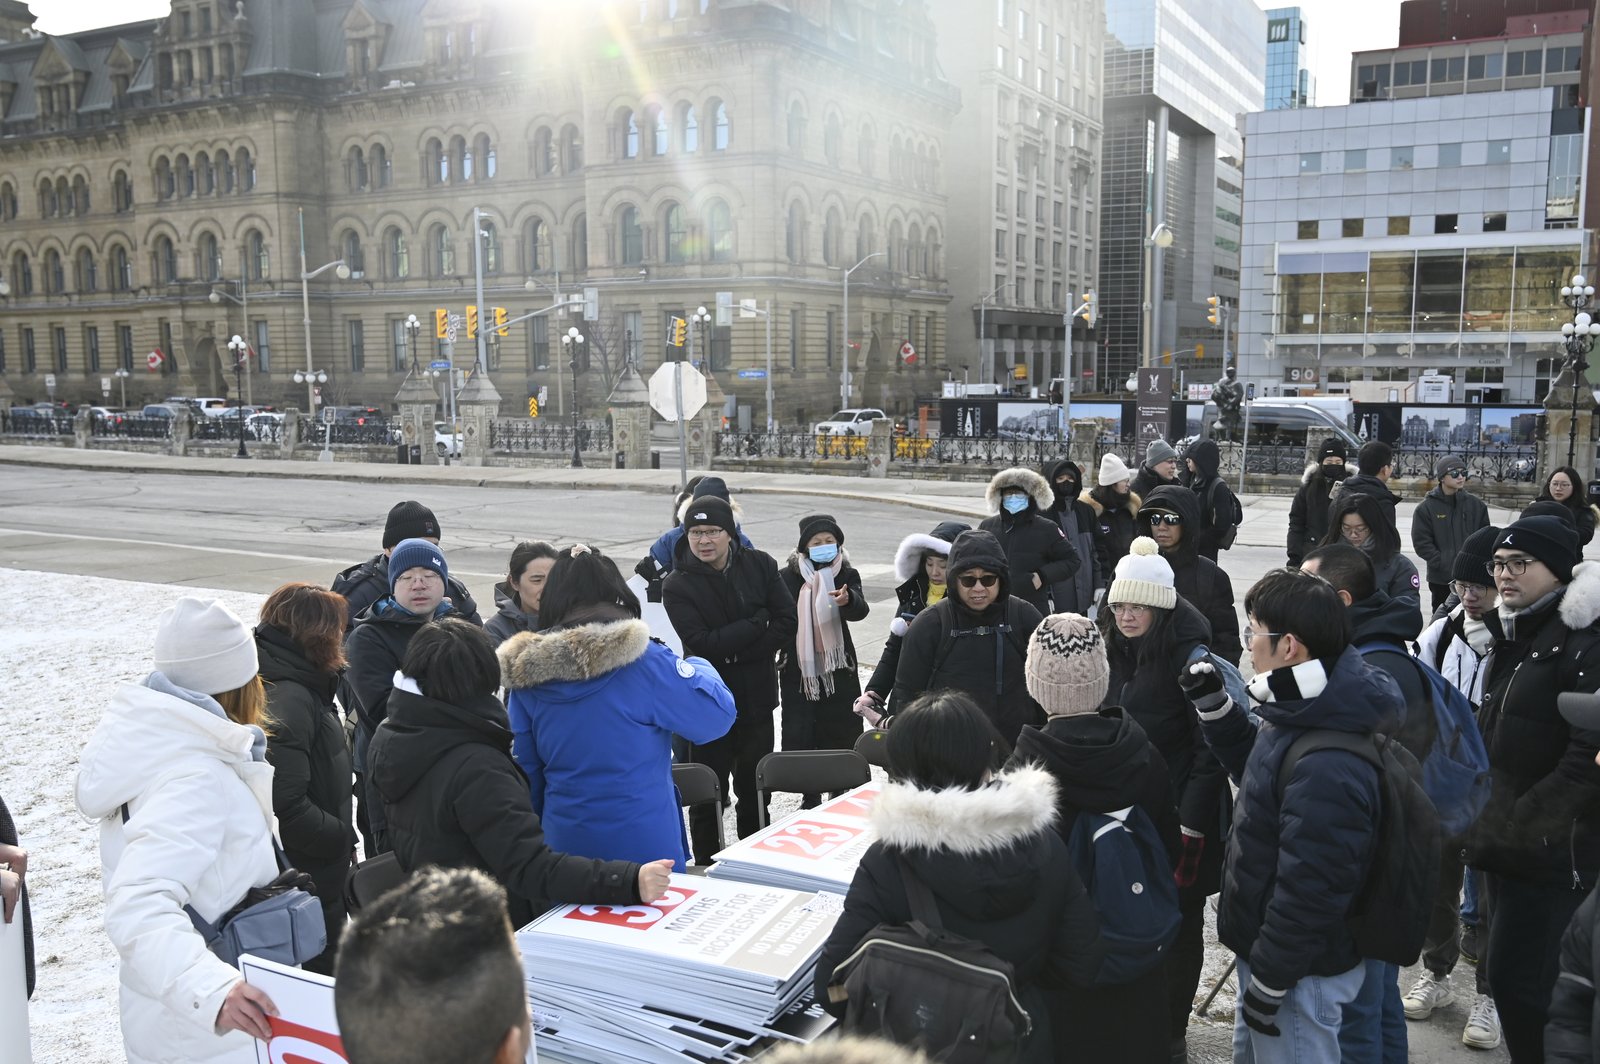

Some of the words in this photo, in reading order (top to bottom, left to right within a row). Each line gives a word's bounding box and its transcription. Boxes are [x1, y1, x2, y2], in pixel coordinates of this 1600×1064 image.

[1291, 369, 1314, 381] 90
[956, 406, 964, 437] CANADA
[763, 823, 853, 856] 23
[664, 896, 720, 932] MONTHS
[678, 909, 734, 945] WAITING
[723, 893, 756, 910] FOR
[698, 934, 737, 957] IRCC
[723, 892, 785, 936] RESPONSE
[747, 942, 772, 956] NO
[773, 943, 797, 957] NO
[786, 912, 828, 944] RESULTS
